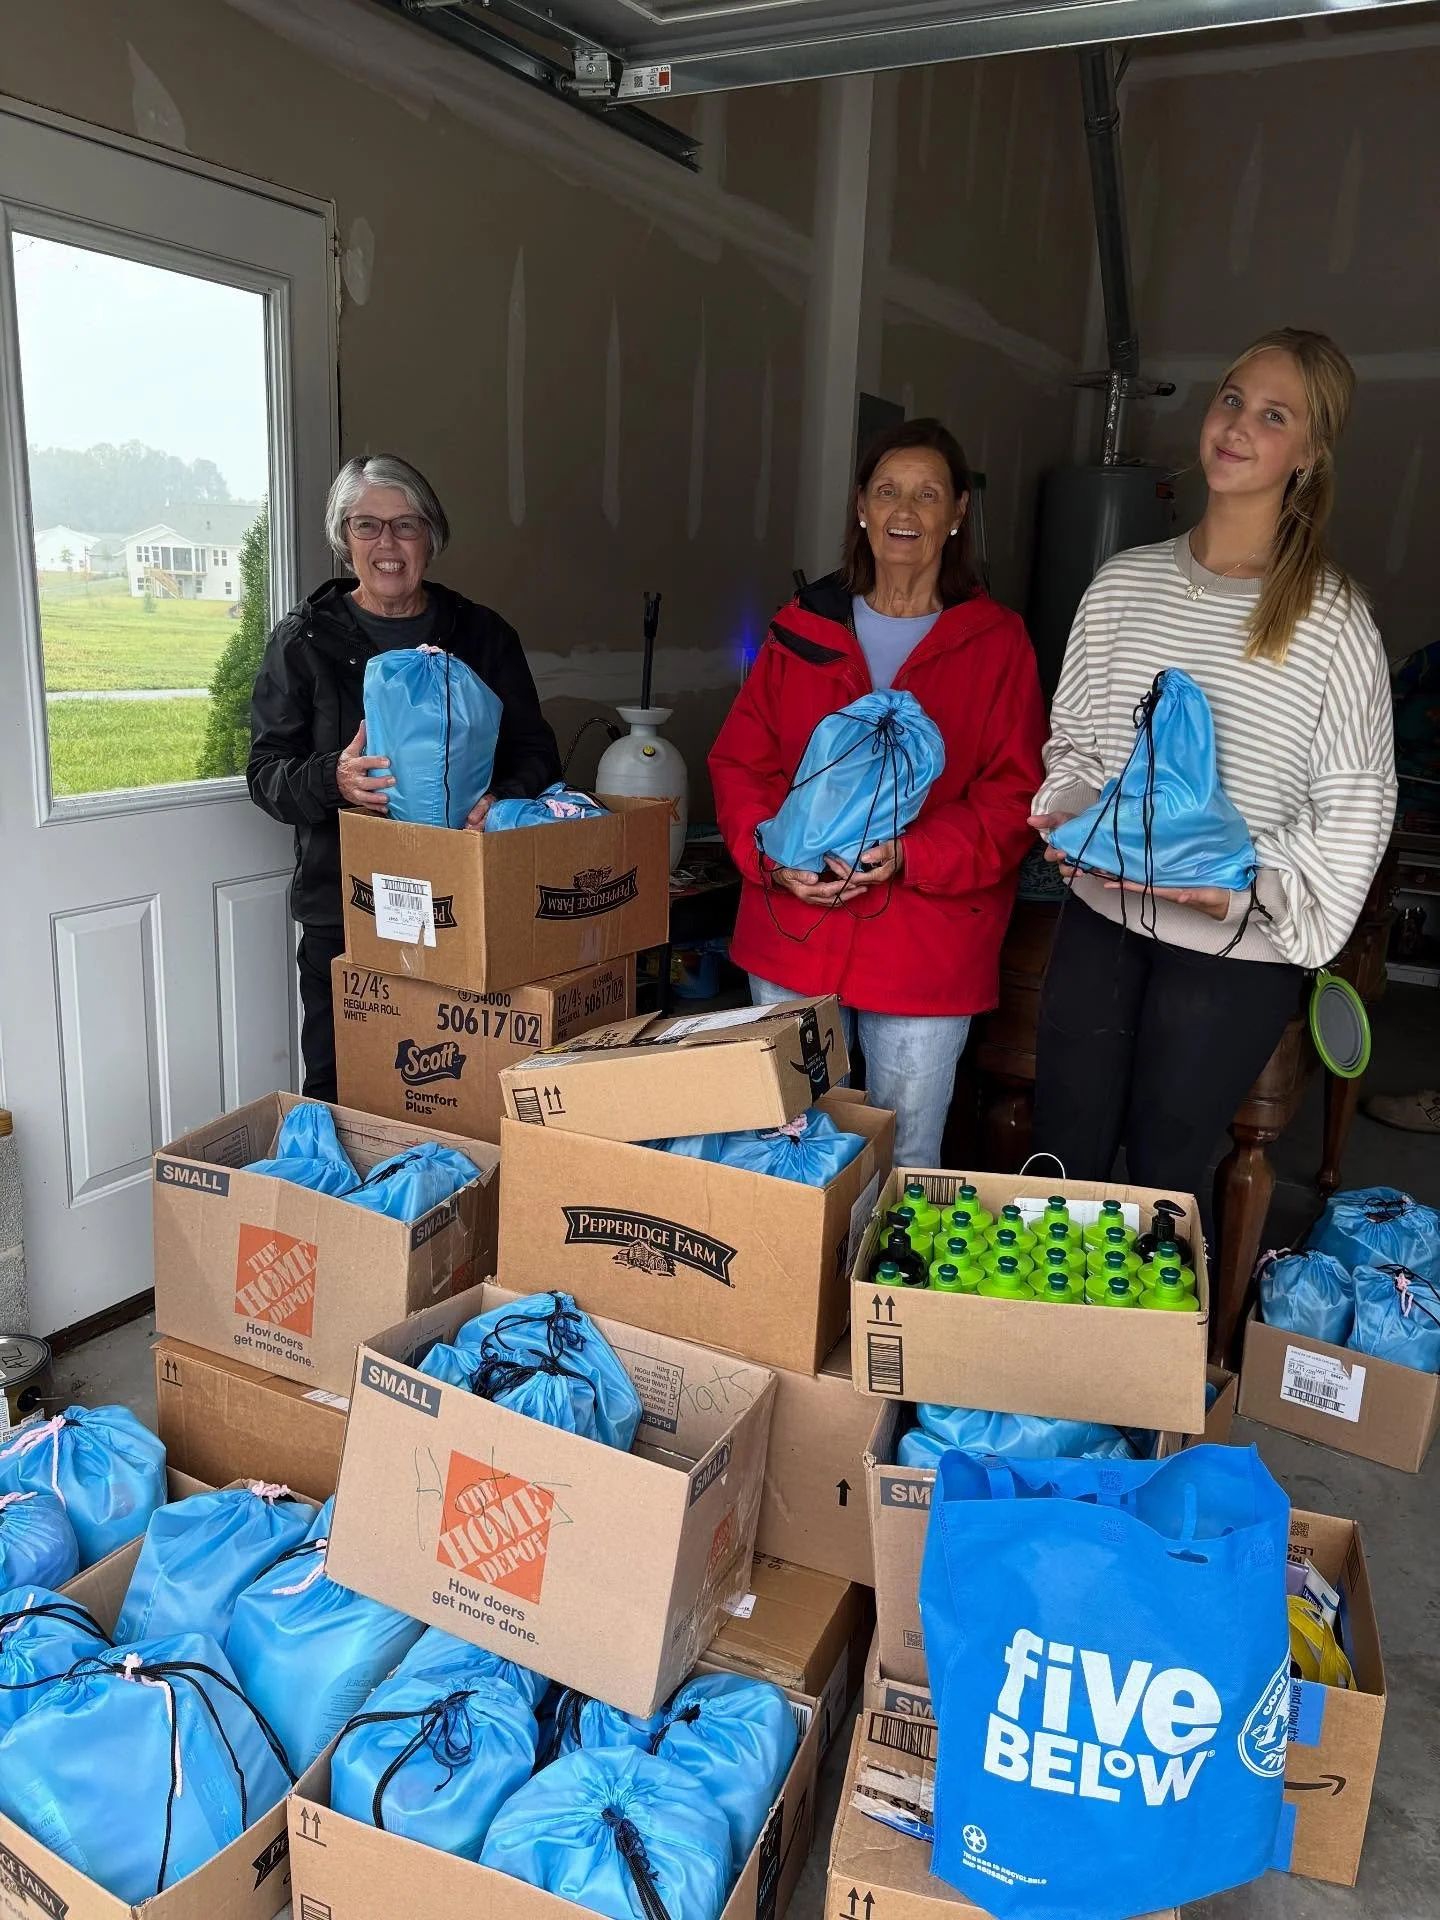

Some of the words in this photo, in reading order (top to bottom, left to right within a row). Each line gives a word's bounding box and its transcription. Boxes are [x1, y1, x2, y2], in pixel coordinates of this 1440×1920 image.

[548, 896, 575, 914] FARM
[577, 880, 631, 910] PEPPERIDGE
[342, 971, 390, 1000] 12/4's
[585, 985, 611, 1016] 50617
[343, 998, 380, 1013] REGULAR
[381, 1004, 401, 1016] ROLL
[343, 1009, 368, 1022] WHITE
[436, 1003, 509, 1039] 50617
[514, 1013, 540, 1044] 02
[404, 1043, 456, 1076] Scott
[405, 1089, 459, 1108] Comfort
[162, 1164, 222, 1191] SMALL
[416, 1200, 457, 1243] SMALL
[578, 1213, 670, 1246] PEPPERIDGE
[674, 1231, 717, 1267] FARM
[246, 1239, 281, 1274] THE
[236, 1240, 317, 1318] HOME
[268, 1278, 315, 1325] DEPOT
[234, 1334, 253, 1346] get
[255, 1340, 283, 1357] more
[285, 1349, 315, 1369] done.
[246, 1322, 272, 1338] How
[273, 1331, 304, 1351] doers
[368, 1365, 432, 1409] SMALL
[646, 1415, 671, 1429] PLACE
[456, 1479, 500, 1513] THE
[439, 1482, 551, 1571] HOME
[476, 1529, 547, 1584] DEPOT
[448, 1577, 481, 1602] How
[483, 1594, 526, 1622] doers
[432, 1590, 456, 1608] get
[458, 1601, 496, 1626] more
[499, 1619, 540, 1646] done.
[1292, 1685, 1303, 1704] and
[1289, 1705, 1300, 1727] now
[1286, 1726, 1300, 1742] it's
[18, 1865, 56, 1914] FARM
[976, 1864, 1014, 1886] REUSABLE
[1001, 1866, 1047, 1885] RECYCLABLE
